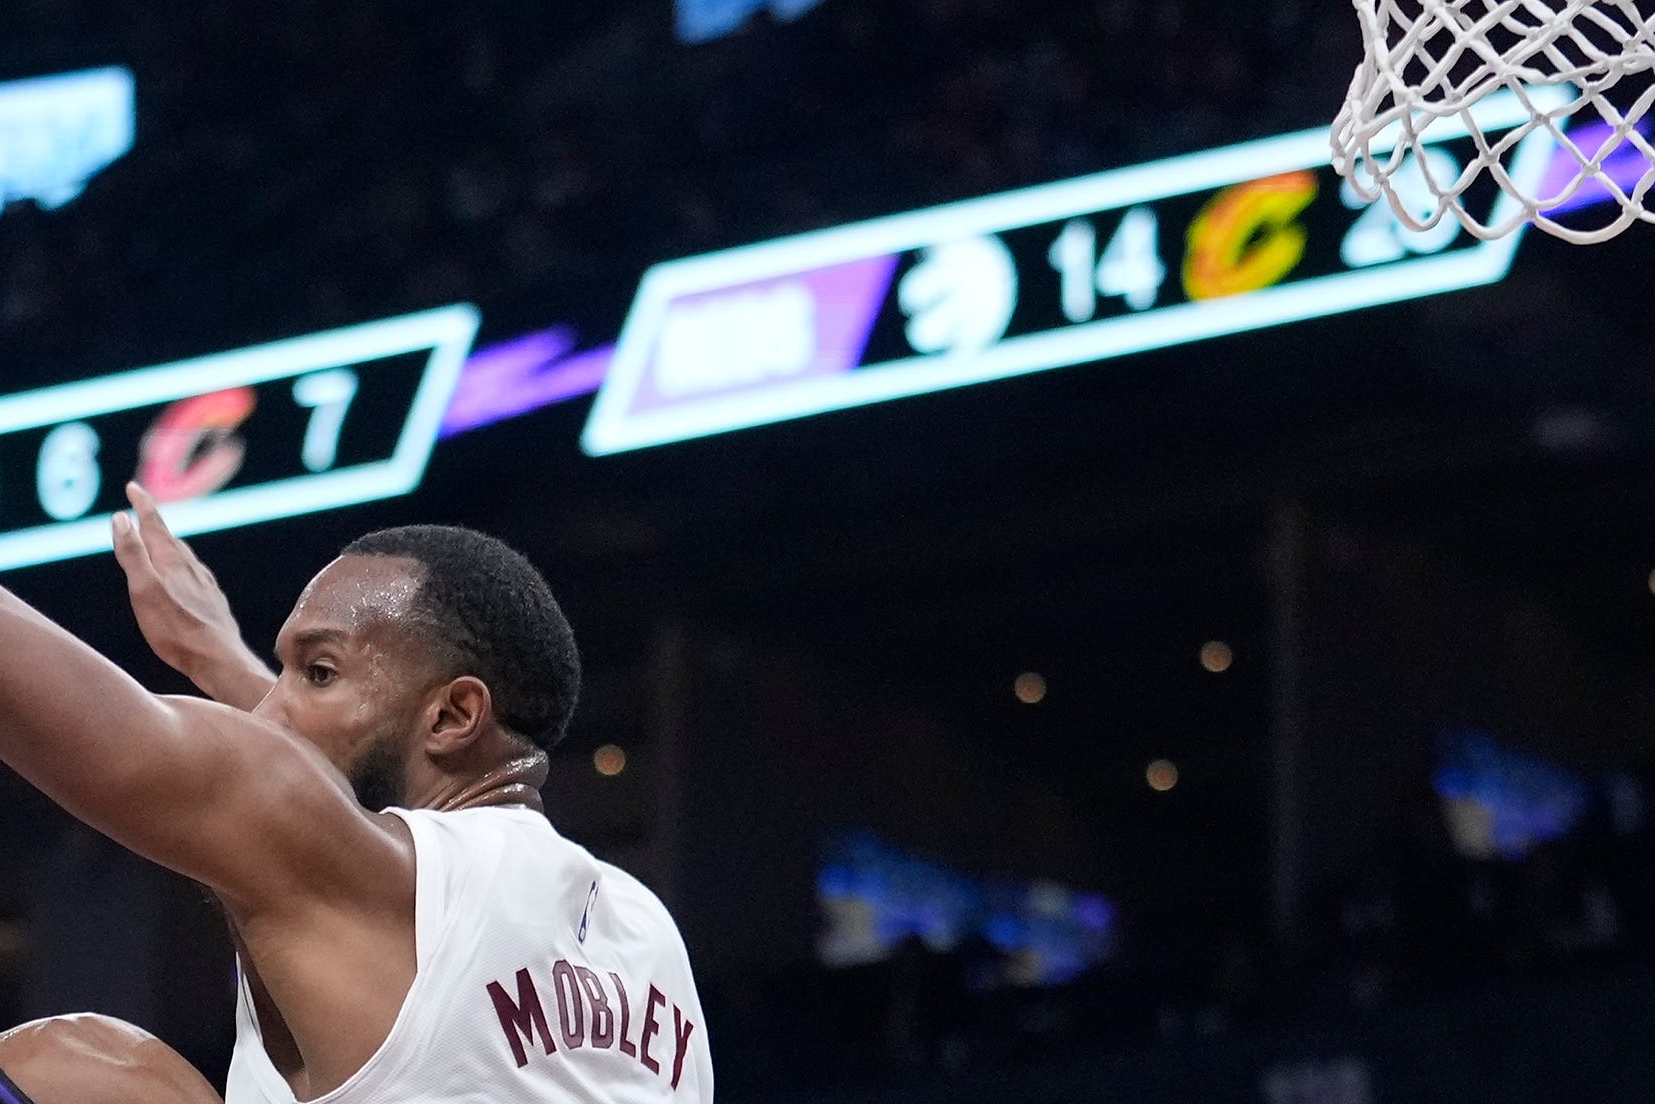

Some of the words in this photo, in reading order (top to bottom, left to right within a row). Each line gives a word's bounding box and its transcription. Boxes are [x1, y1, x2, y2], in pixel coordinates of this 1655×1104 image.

[1049, 208, 1166, 322] 14
[35, 422, 102, 521] 6
[292, 368, 359, 472] 7
[486, 959, 694, 1091] MOBLEY
